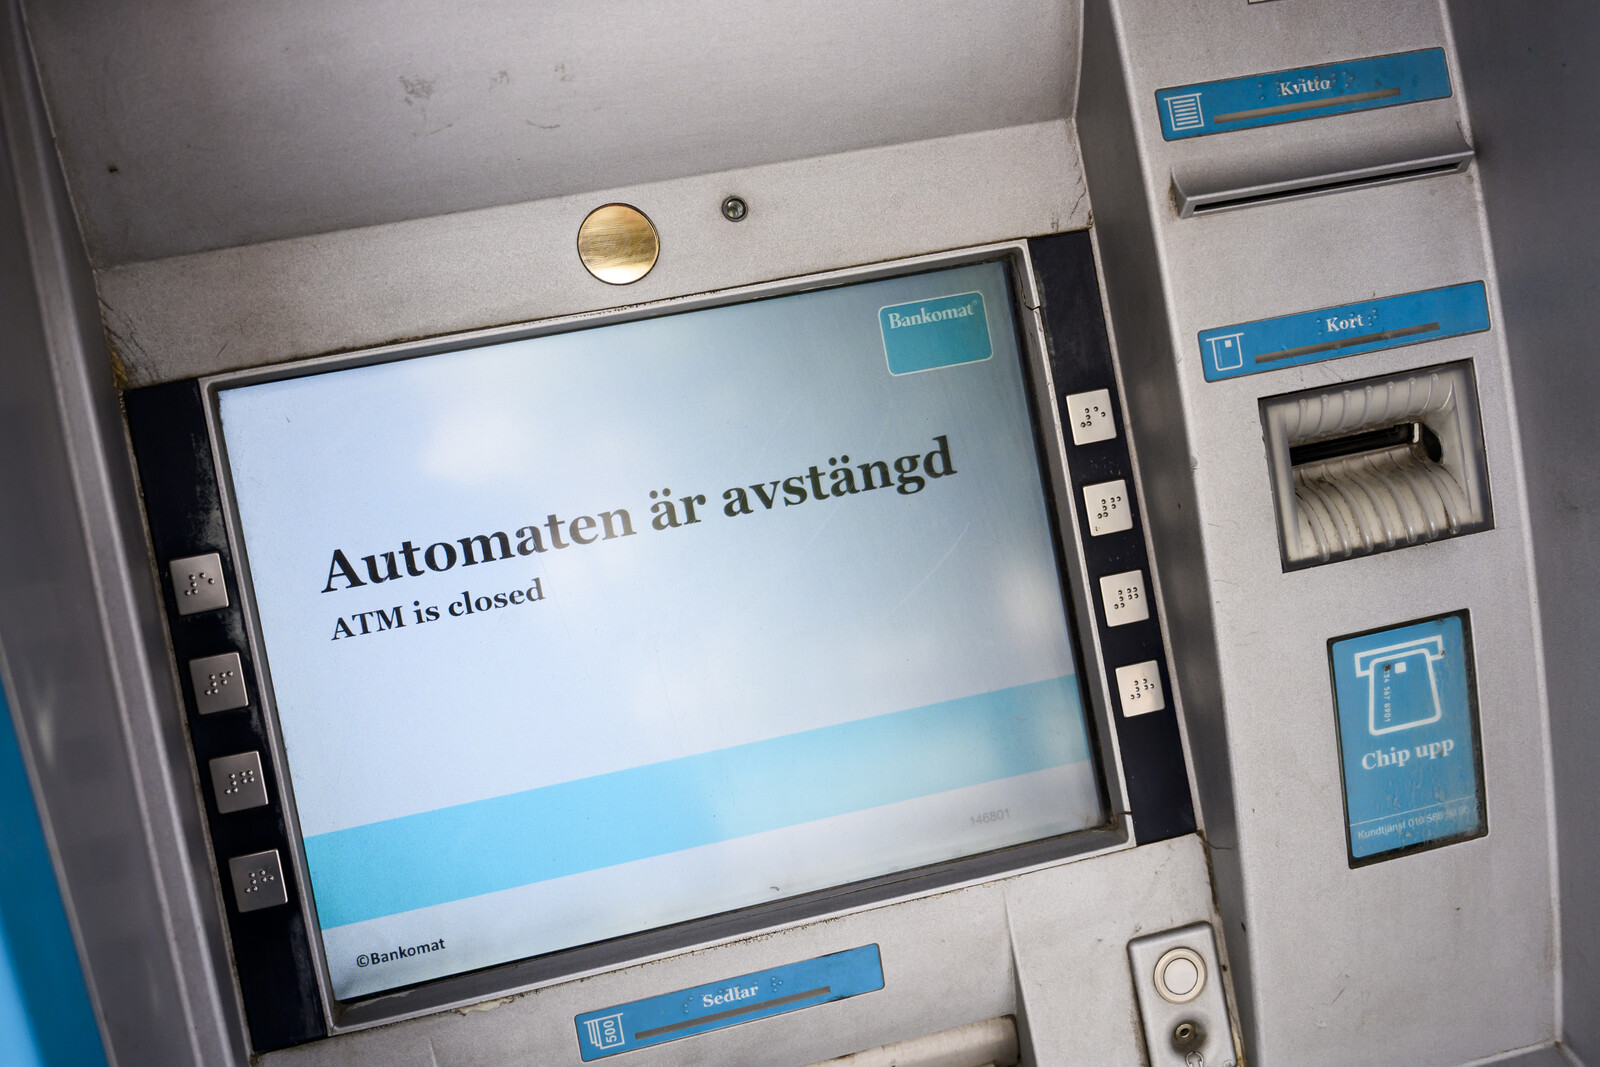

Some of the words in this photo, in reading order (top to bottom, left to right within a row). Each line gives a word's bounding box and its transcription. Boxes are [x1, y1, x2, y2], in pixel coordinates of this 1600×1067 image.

[1279, 78, 1331, 97] Kvitto
[887, 303, 975, 330] Bankomat
[1326, 313, 1365, 333] Kort
[320, 508, 637, 594] Automaten
[650, 487, 707, 531] är
[722, 435, 958, 519] avstängd
[330, 605, 407, 641] ATM
[414, 600, 441, 625] is
[447, 578, 546, 617] closed
[1361, 746, 1411, 771] Chip
[1415, 738, 1455, 760] upp
[702, 984, 759, 1008] Sedlar
[604, 1018, 618, 1044] 500
